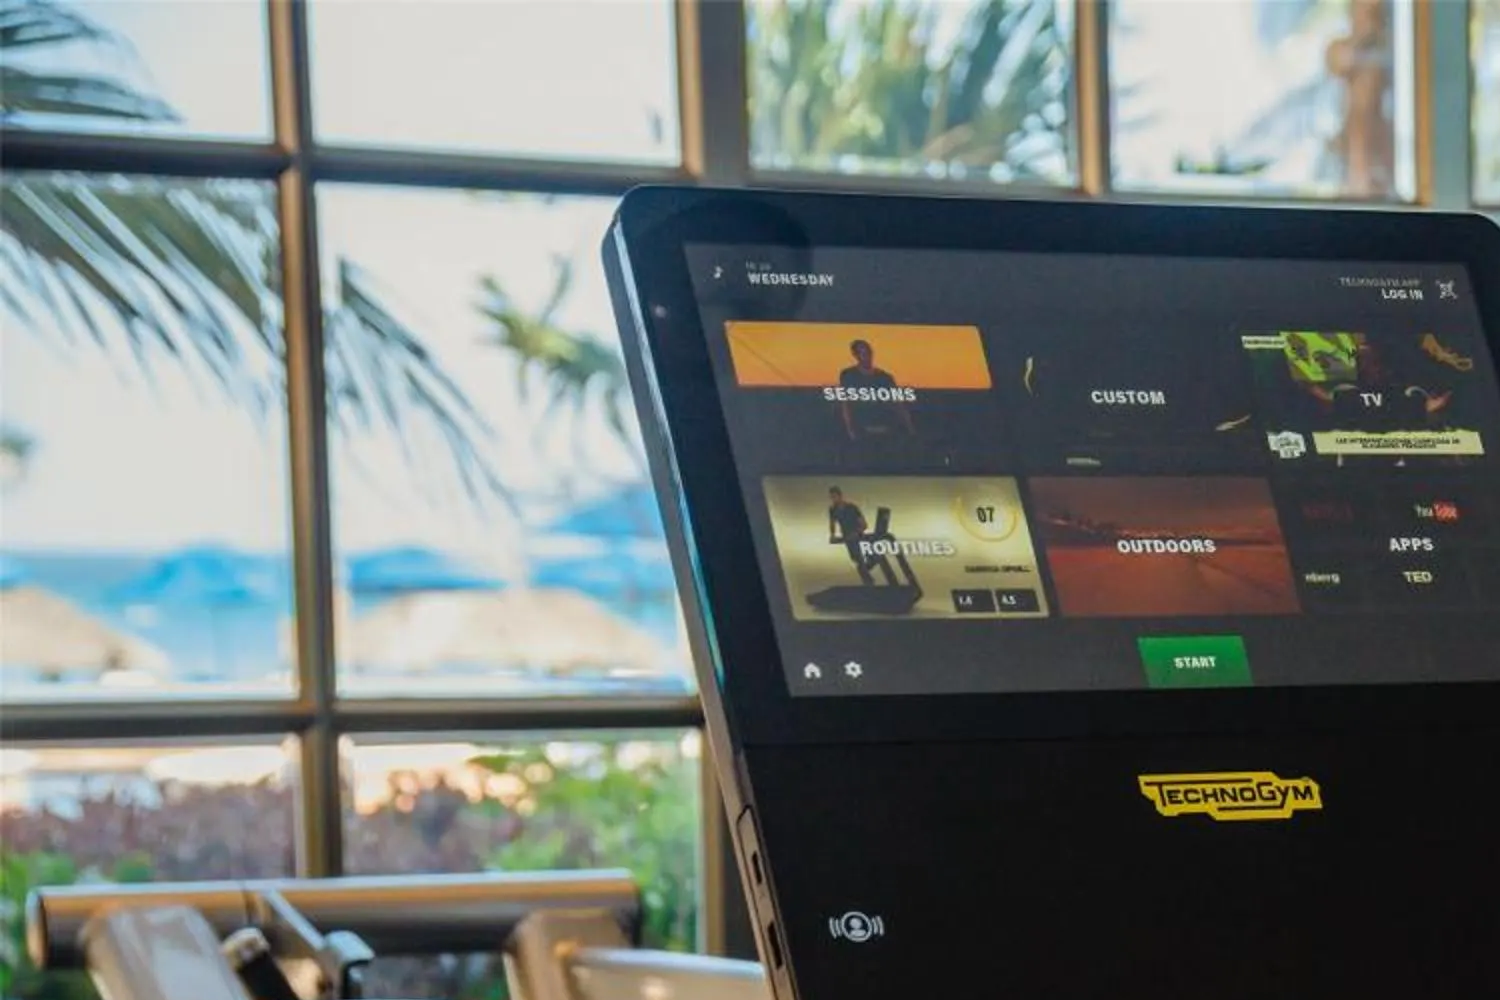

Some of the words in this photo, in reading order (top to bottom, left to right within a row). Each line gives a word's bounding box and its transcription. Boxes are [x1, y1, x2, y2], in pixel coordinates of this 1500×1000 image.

[747, 272, 834, 286] WEDNESDAY
[1381, 288, 1408, 300] LOG
[823, 387, 917, 402] SESSIONS
[1090, 390, 1166, 405] CUSTOM
[1360, 393, 1383, 408] TV
[976, 507, 994, 523] 07
[858, 540, 955, 558] ROUTINES
[1117, 538, 1217, 554] OUTDOORS
[1389, 537, 1434, 553] APPS
[1403, 571, 1433, 584] TED
[1174, 655, 1217, 670] START
